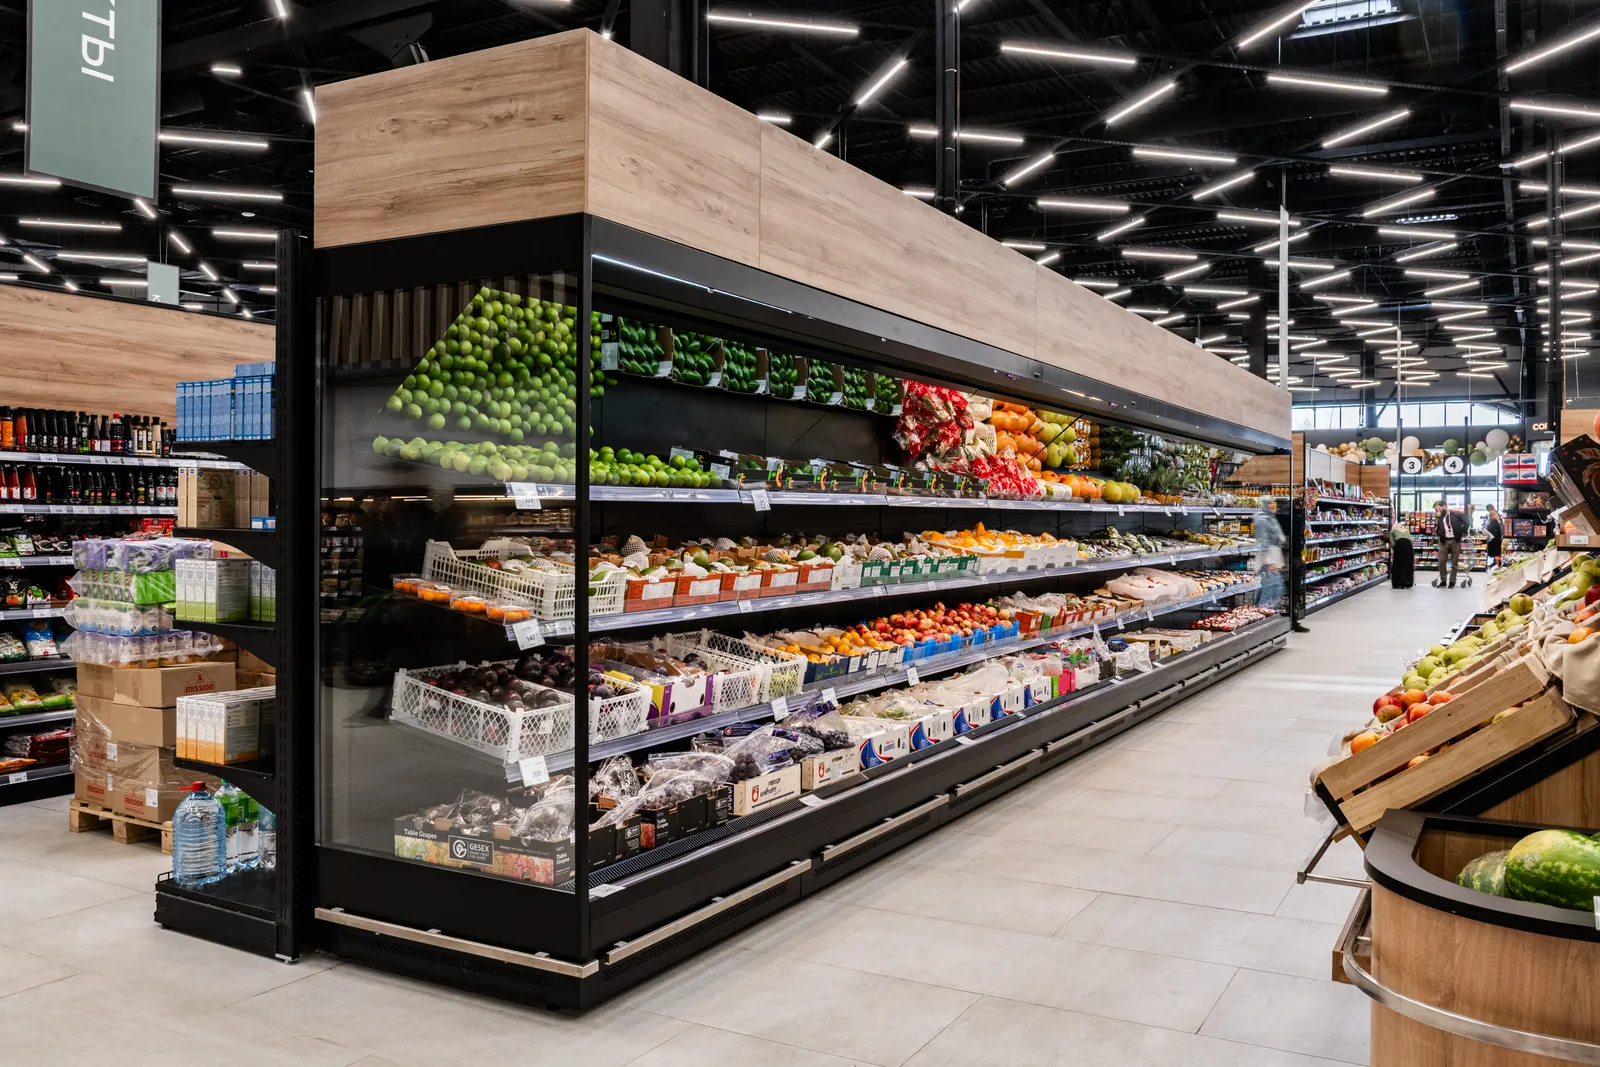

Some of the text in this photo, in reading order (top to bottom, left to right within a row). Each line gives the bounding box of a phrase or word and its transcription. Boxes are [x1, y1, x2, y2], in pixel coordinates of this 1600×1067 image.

[81, 0, 115, 82] ТЫ
[1408, 461, 1415, 470] 3
[1449, 460, 1457, 469] 4
[403, 828, 437, 840] Table Grapes
[469, 843, 490, 853] GESEX
[556, 852, 568, 860] Table
[556, 857, 570, 865] Grapes
